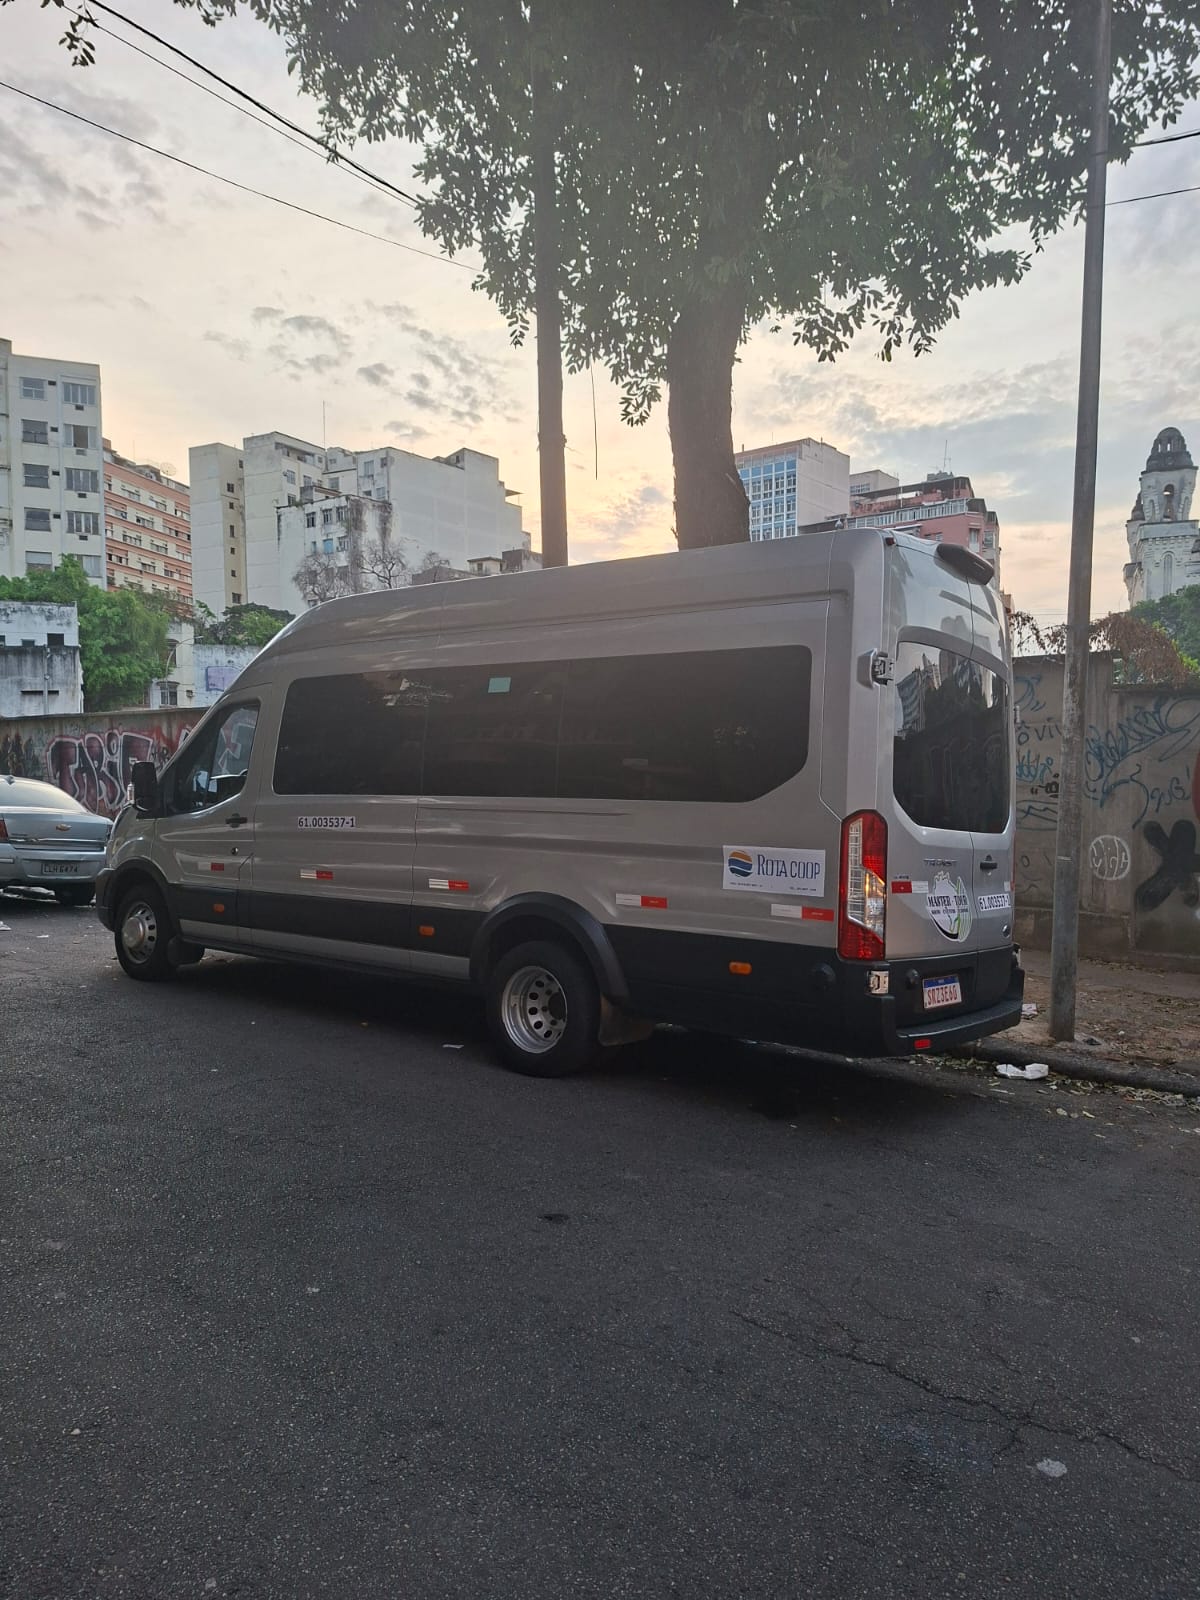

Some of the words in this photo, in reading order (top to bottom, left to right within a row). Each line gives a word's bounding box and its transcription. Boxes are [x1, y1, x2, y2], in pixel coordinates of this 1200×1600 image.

[298, 816, 355, 828] 61.003537-1
[757, 854, 788, 877] ROTA
[790, 860, 821, 879] COOP
[927, 895, 952, 907] MASTER
[953, 895, 969, 906] TOUR
